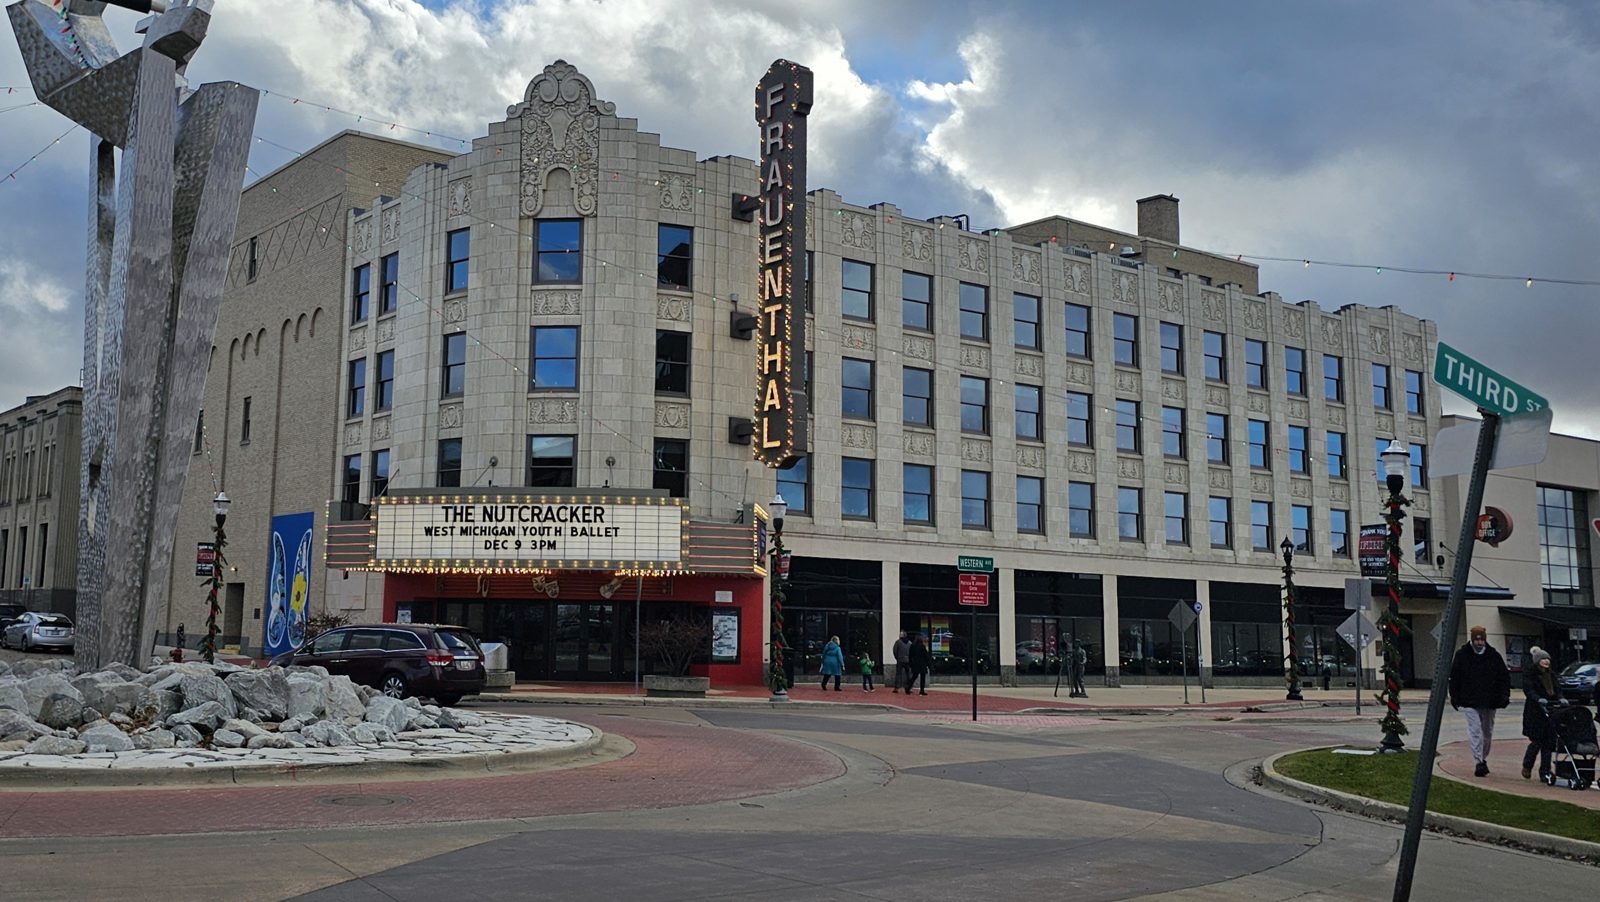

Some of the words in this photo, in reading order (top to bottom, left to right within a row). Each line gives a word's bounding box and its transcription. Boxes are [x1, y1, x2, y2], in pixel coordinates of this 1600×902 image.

[762, 82, 785, 449] FRAUENTHAL
[1444, 353, 1519, 413] THIRD
[1526, 399, 1542, 412] ST
[441, 505, 476, 523] THE
[482, 505, 605, 523] NUTCRACKER
[424, 526, 456, 537] WEST
[460, 526, 516, 537] MICHIGAN
[522, 526, 562, 537] YOUTH
[570, 526, 620, 537] BALLET
[484, 539, 509, 550] DEC
[514, 540, 522, 550] 9
[960, 558, 984, 568] WESTERN
